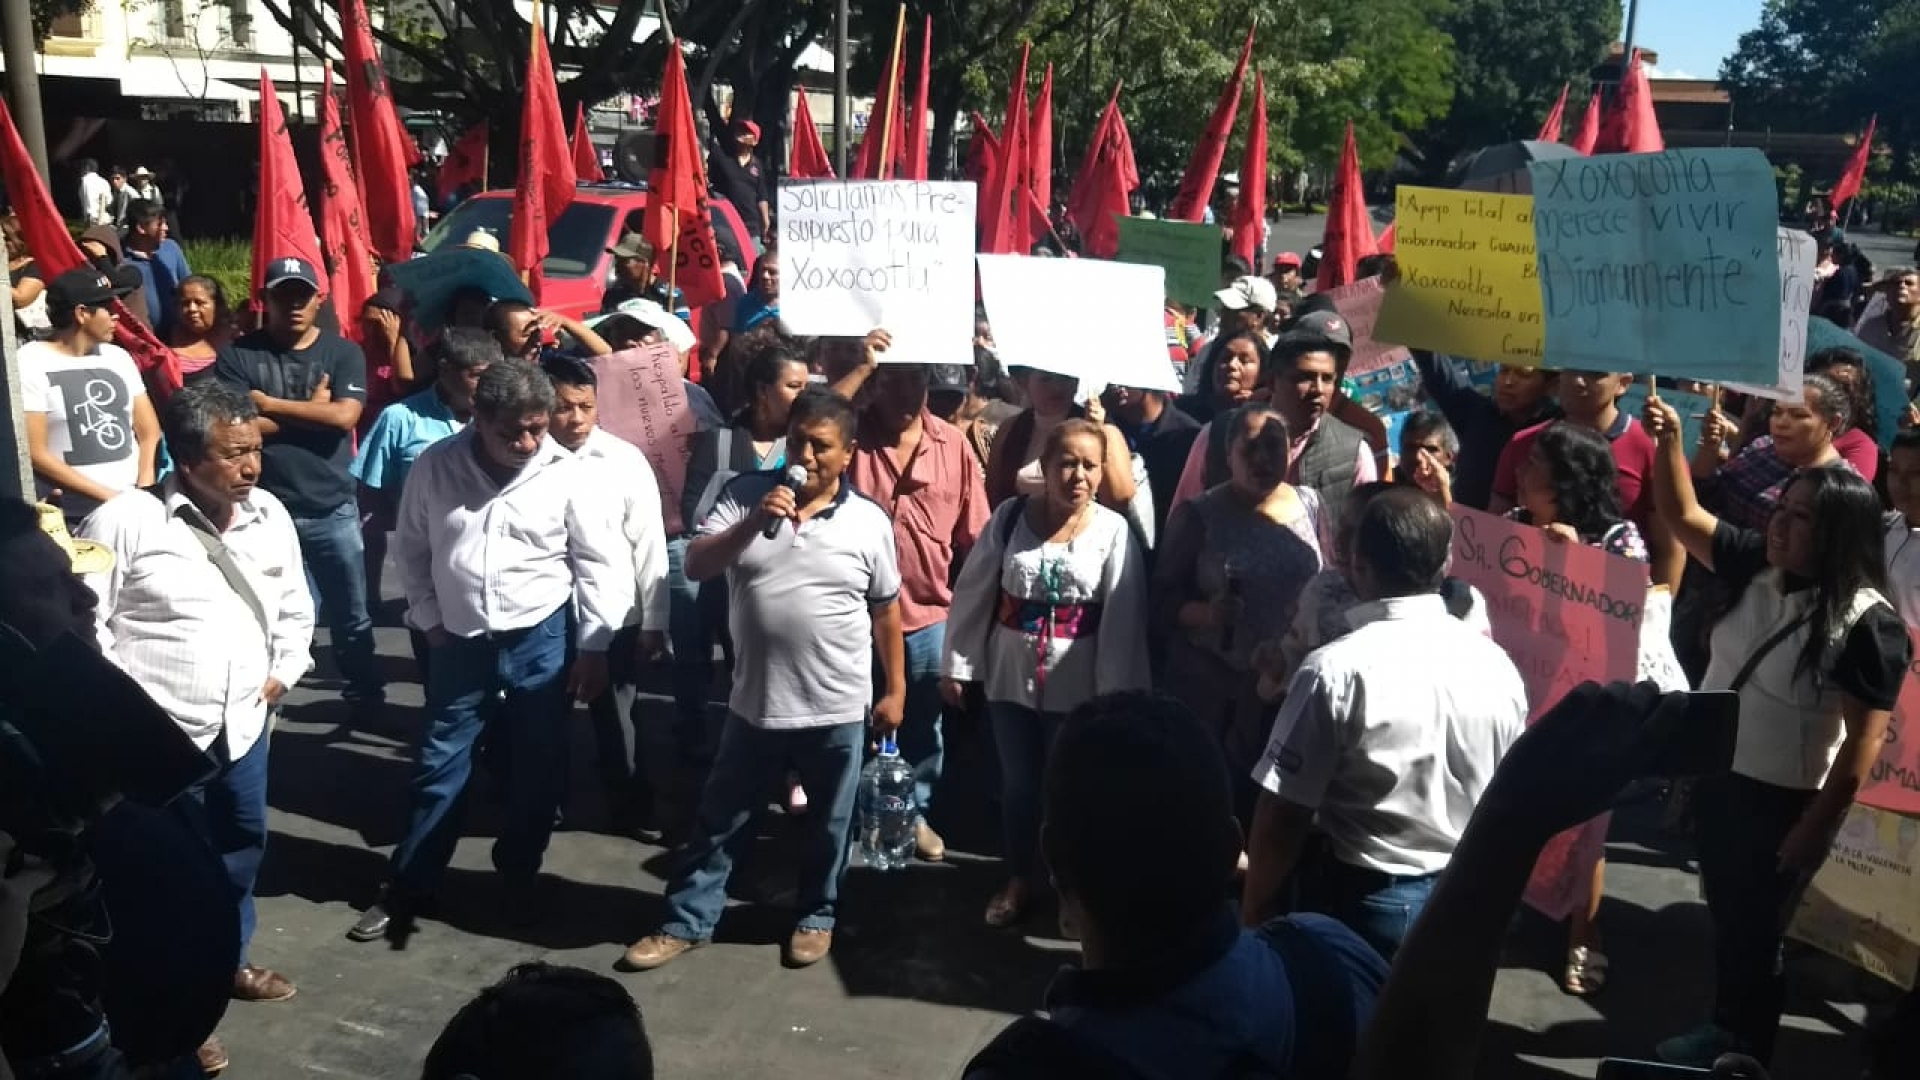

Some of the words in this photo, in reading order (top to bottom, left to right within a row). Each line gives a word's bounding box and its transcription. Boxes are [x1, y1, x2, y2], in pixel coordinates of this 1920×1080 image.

[783, 181, 907, 213] Solicitamos
[788, 211, 874, 252] supuesto
[1536, 208, 1632, 249] merece
[1406, 264, 1494, 297] Xoxocotla
